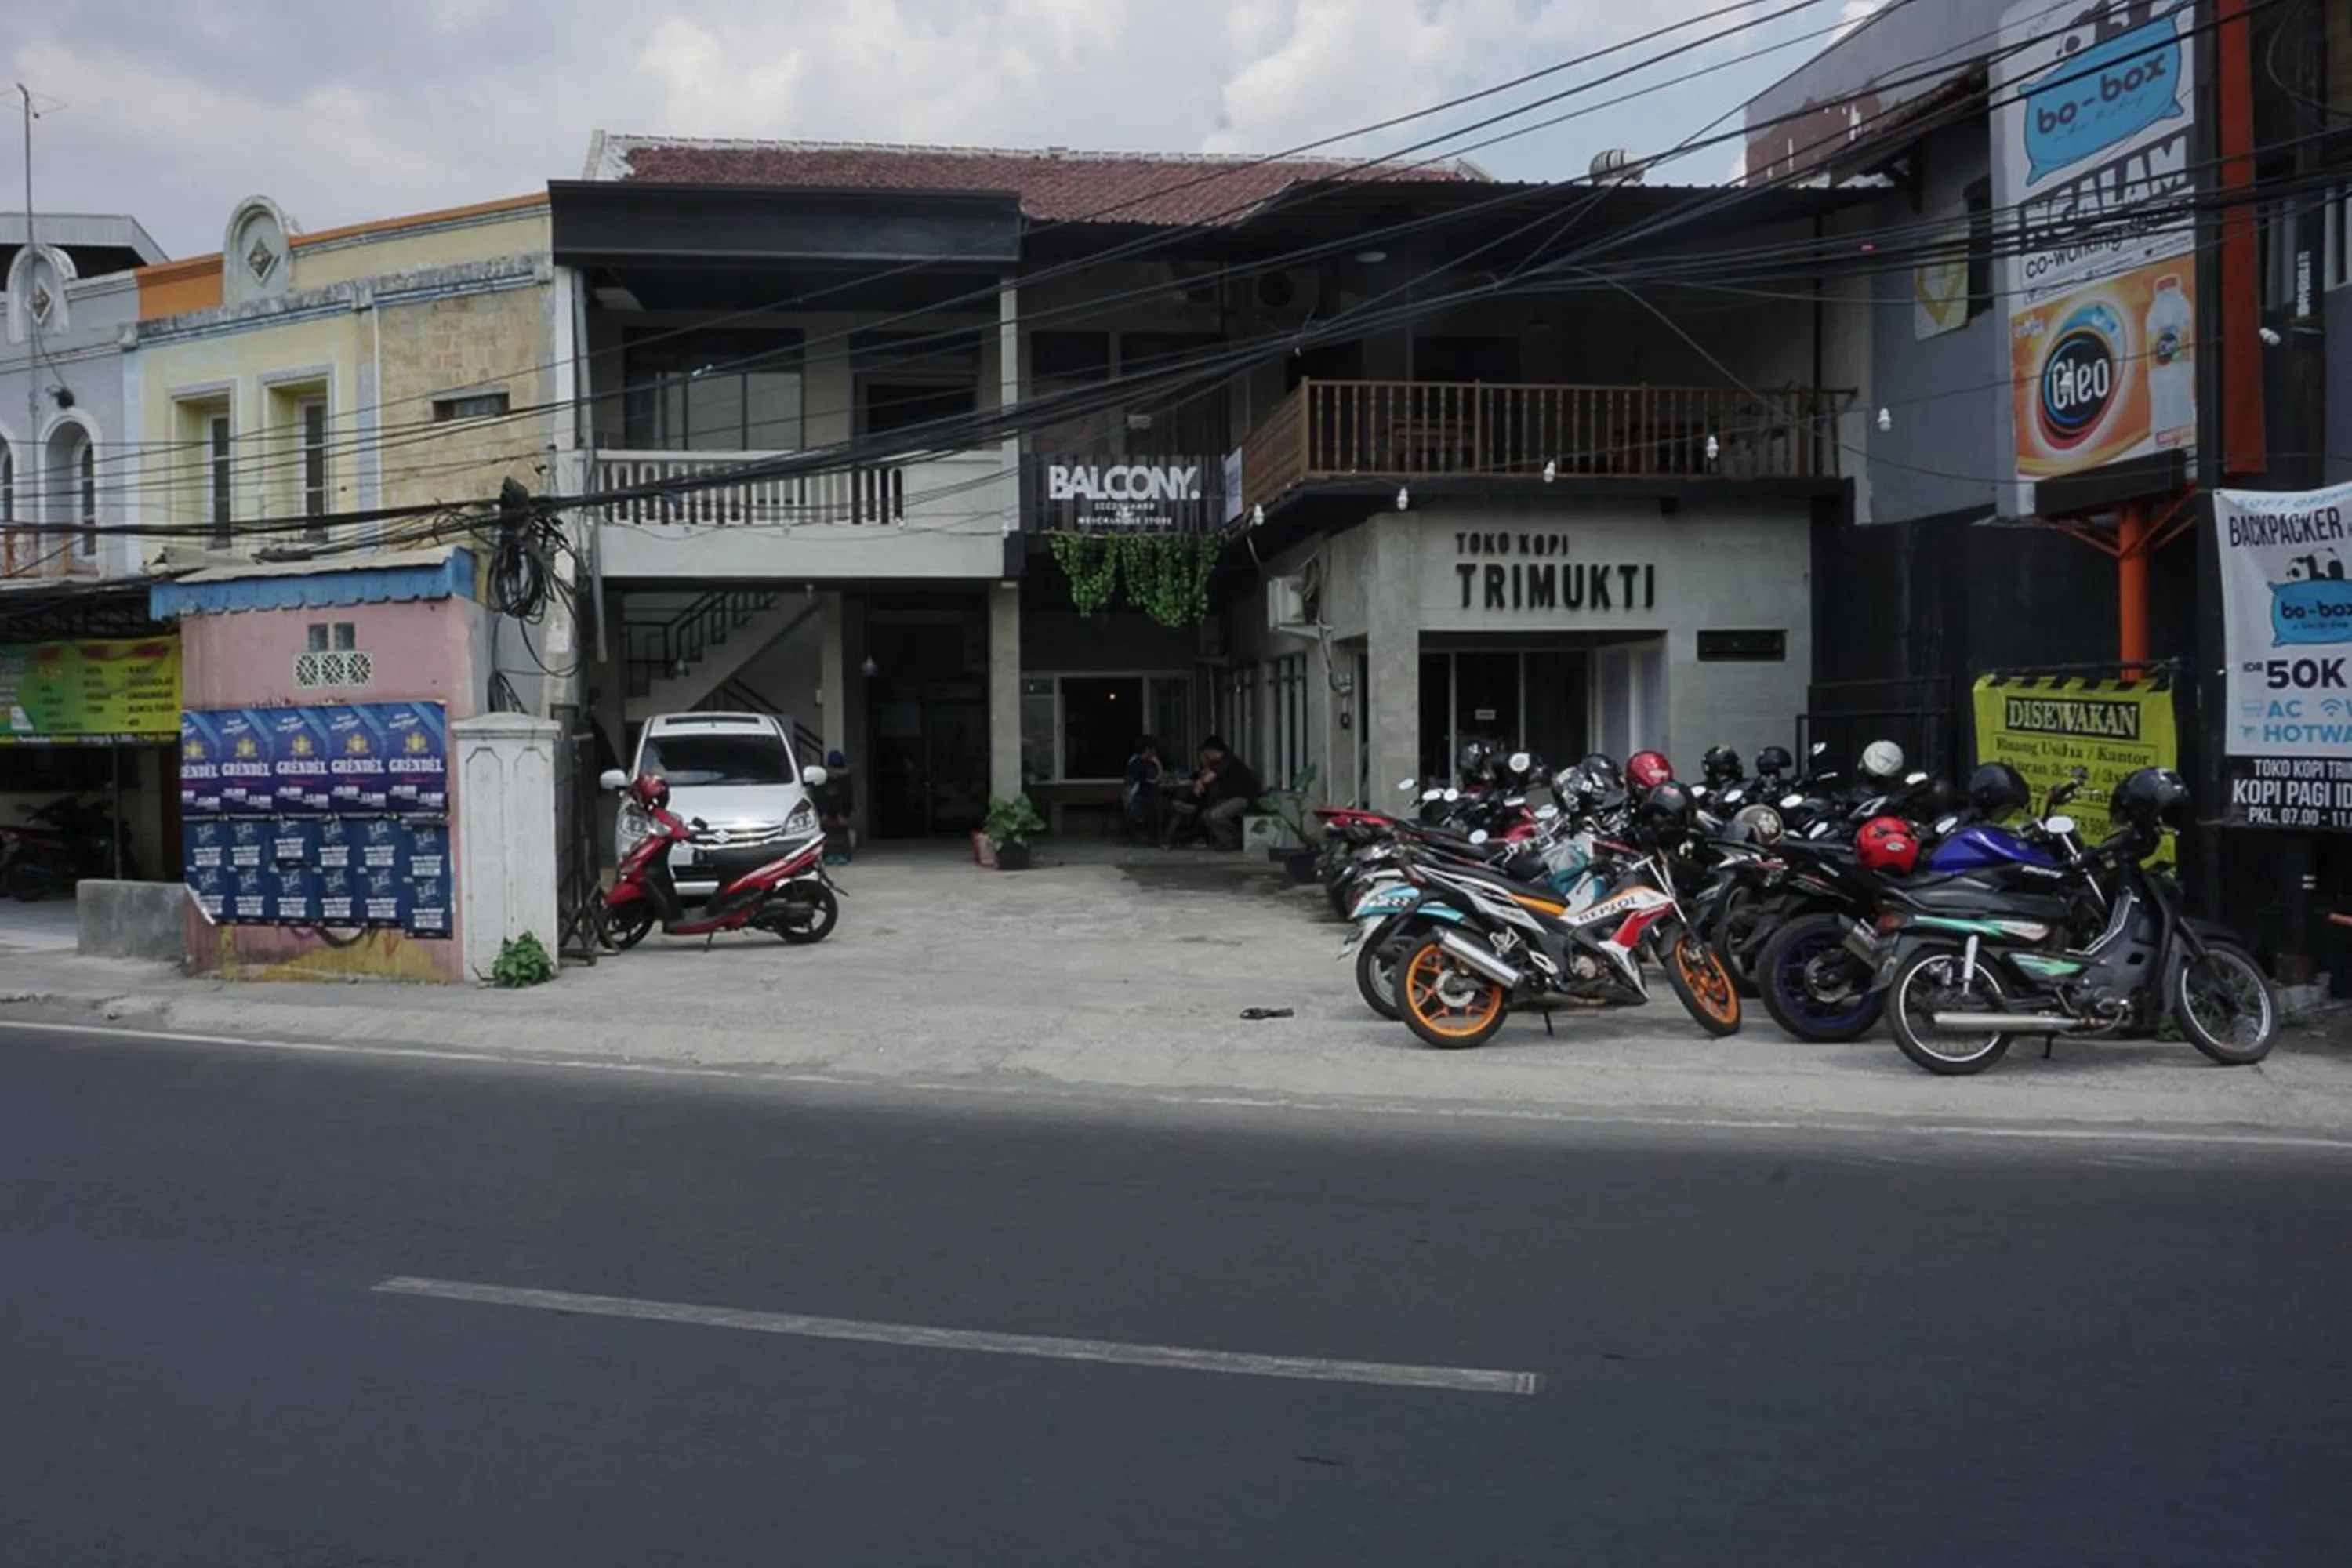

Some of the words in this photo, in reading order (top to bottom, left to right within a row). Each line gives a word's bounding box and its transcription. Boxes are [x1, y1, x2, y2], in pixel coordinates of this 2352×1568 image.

[2053, 358, 2109, 411] Cleo
[2230, 506, 2343, 546] BACKPACKER
[1455, 532, 1510, 555] TOKO
[1518, 534, 1569, 556] KOPI
[1456, 564, 1655, 610] TRIMUKTI
[2267, 657, 2347, 689] 50K
[2009, 700, 2137, 735] DISEWAKAN
[2267, 699, 2303, 718] AC
[2097, 746, 2151, 765] Kantor
[2253, 759, 2291, 778] TOKO
[2293, 760, 2325, 779] KOPI
[2233, 779, 2281, 805] KOPI
[2286, 781, 2331, 808] PAGI
